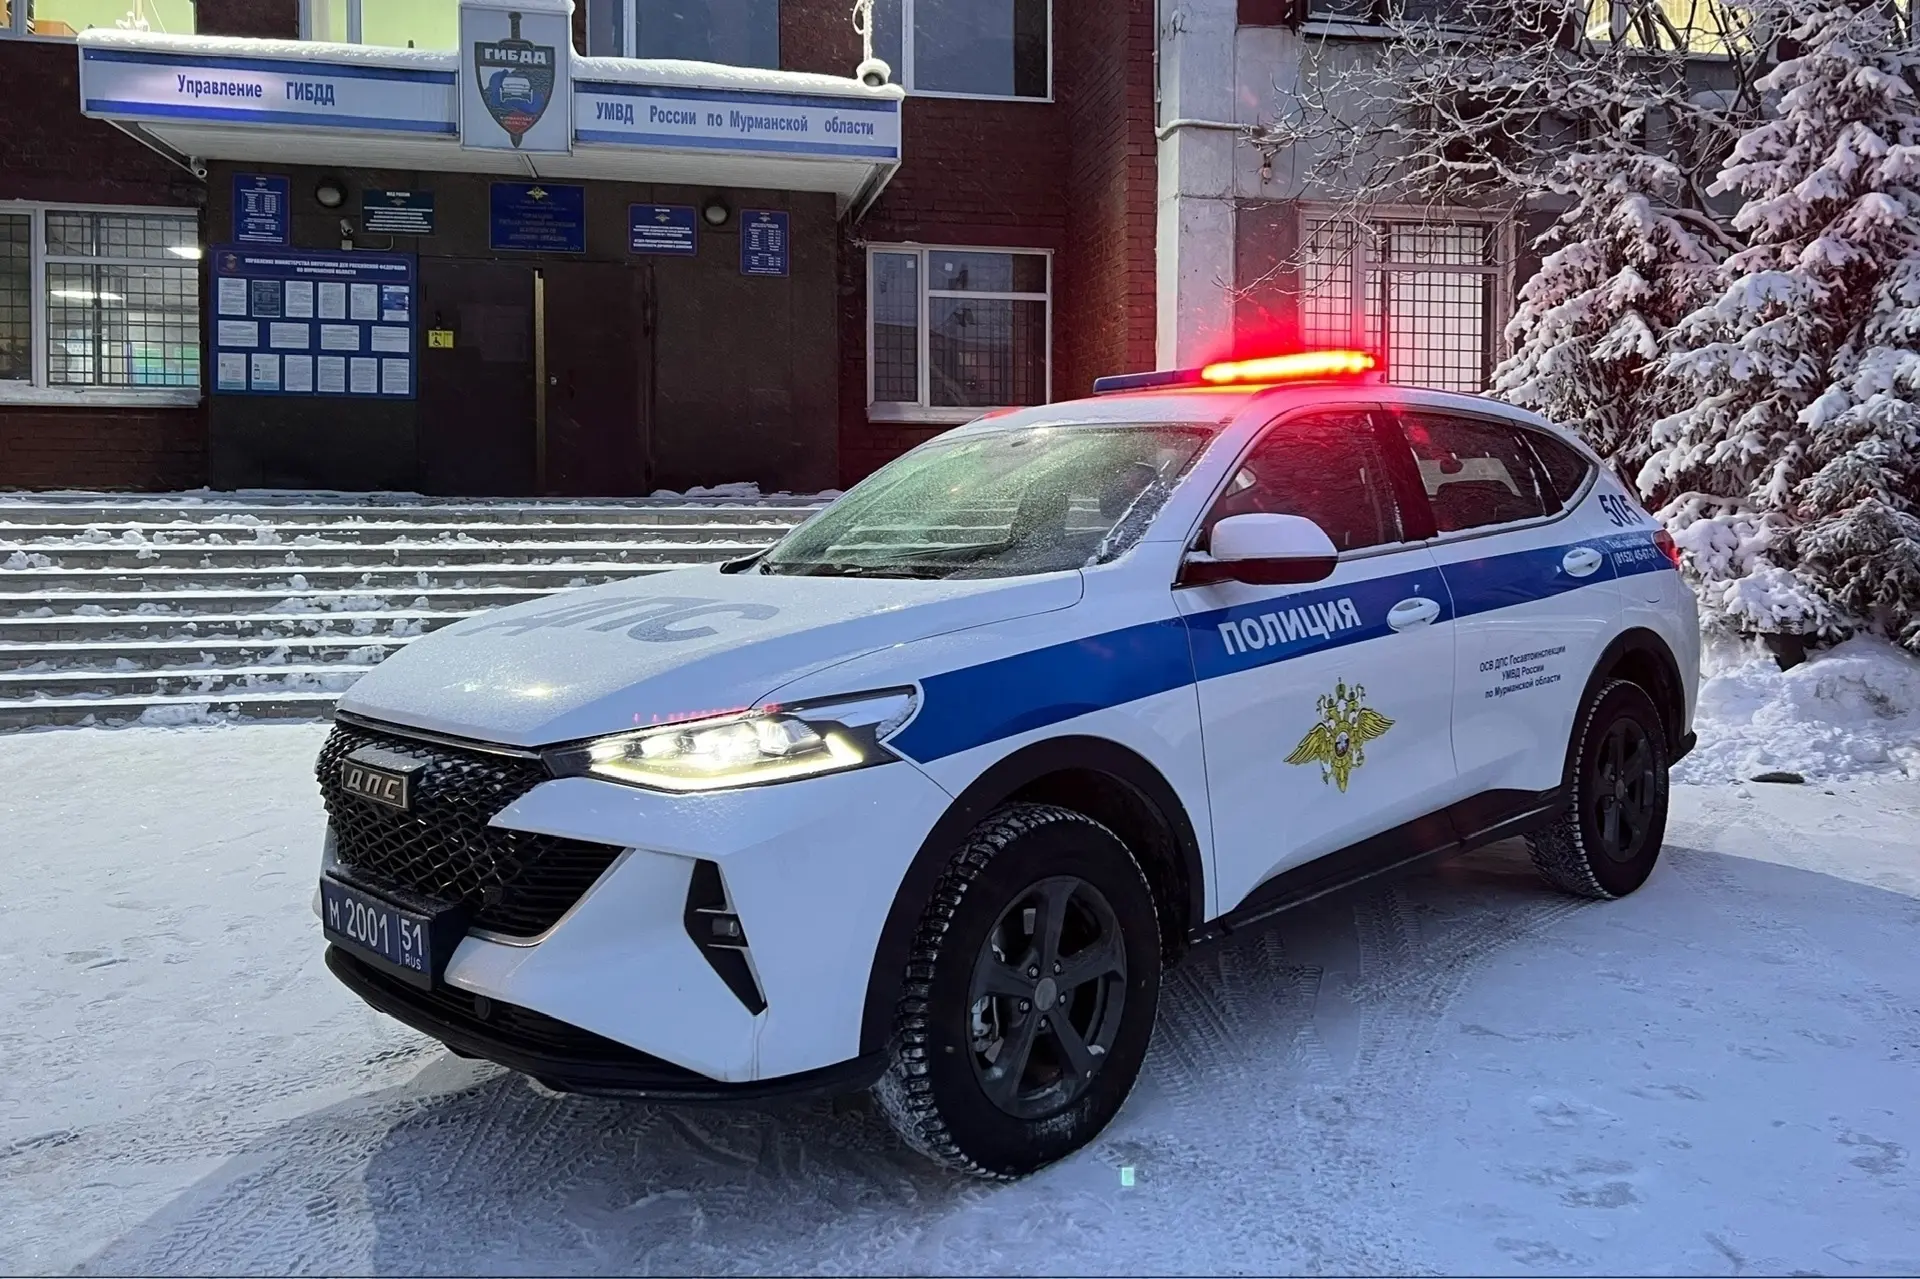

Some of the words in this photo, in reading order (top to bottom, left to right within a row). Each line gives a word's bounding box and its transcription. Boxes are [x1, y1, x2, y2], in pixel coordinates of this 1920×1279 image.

[484, 48, 546, 64] ГИБДД
[178, 74, 263, 99] Управление
[286, 81, 335, 106] ГИБДД
[596, 101, 634, 126] УМВД
[650, 107, 696, 126] России
[707, 112, 723, 129] по
[730, 109, 808, 134] Мурманской
[825, 117, 874, 136] области
[1598, 494, 1645, 527] 505
[1217, 598, 1362, 655] ПОЛИЦИЯ
[1495, 656, 1509, 670] ДПС
[1502, 668, 1520, 681] УМВД
[1522, 664, 1544, 676] России
[1485, 690, 1493, 699] по
[1494, 678, 1533, 698] Мурманской
[1535, 674, 1561, 687] области
[347, 769, 400, 799] ДПС
[329, 898, 341, 931] М
[345, 898, 390, 954] 2001
[401, 918, 423, 957] 51
[404, 952, 422, 970] RUS
